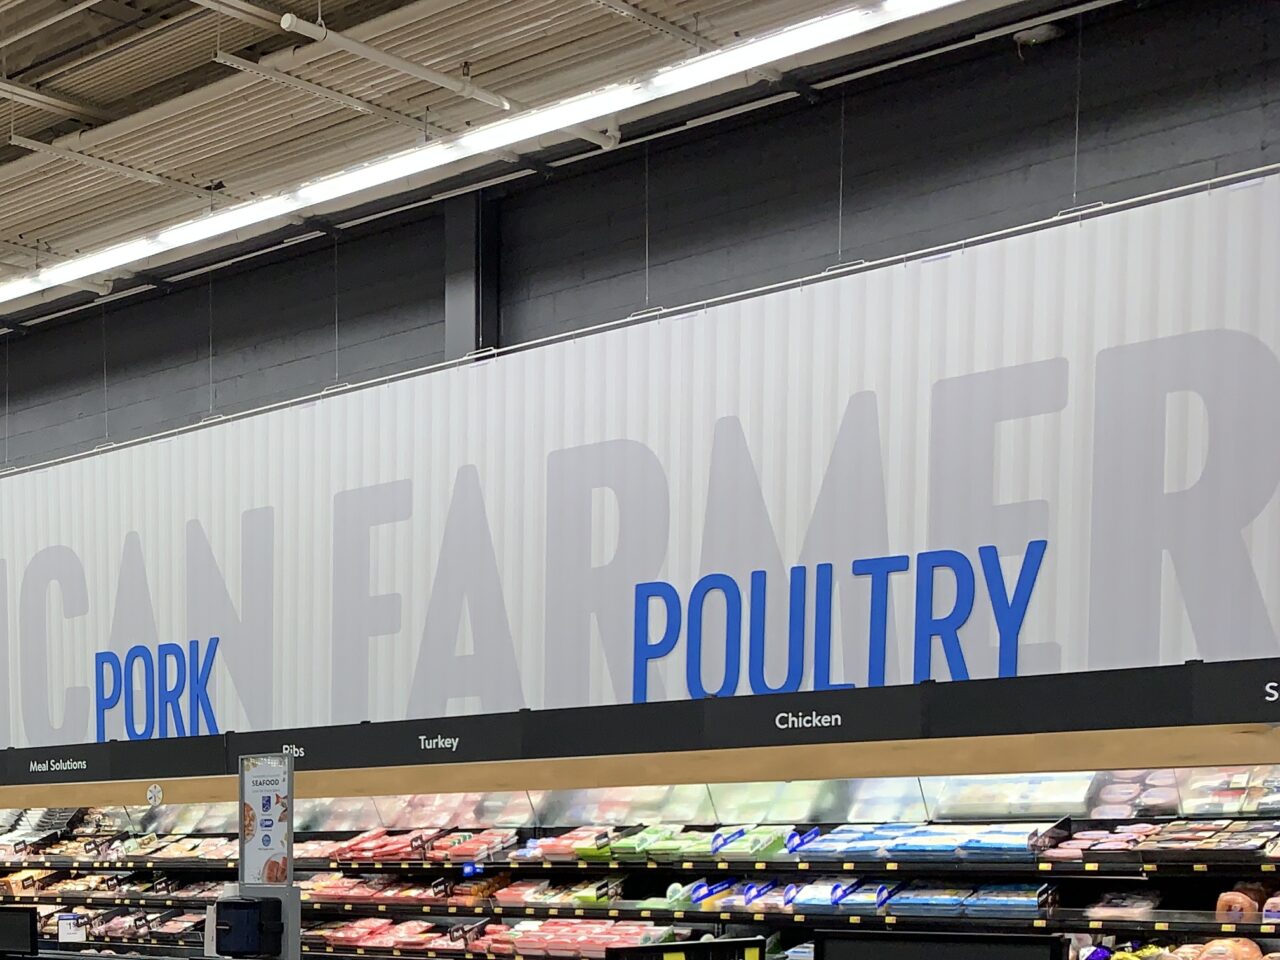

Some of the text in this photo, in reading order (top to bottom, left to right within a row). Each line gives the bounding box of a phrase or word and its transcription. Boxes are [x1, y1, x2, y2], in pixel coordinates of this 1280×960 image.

[633, 539, 1048, 704] POULTRY
[95, 636, 220, 744] PORK
[775, 711, 841, 729] Chicken
[282, 744, 305, 757] Ribs
[419, 735, 459, 751] Turkey
[29, 758, 87, 772] Meal Solutions
[252, 779, 279, 787] SEAFOOD
